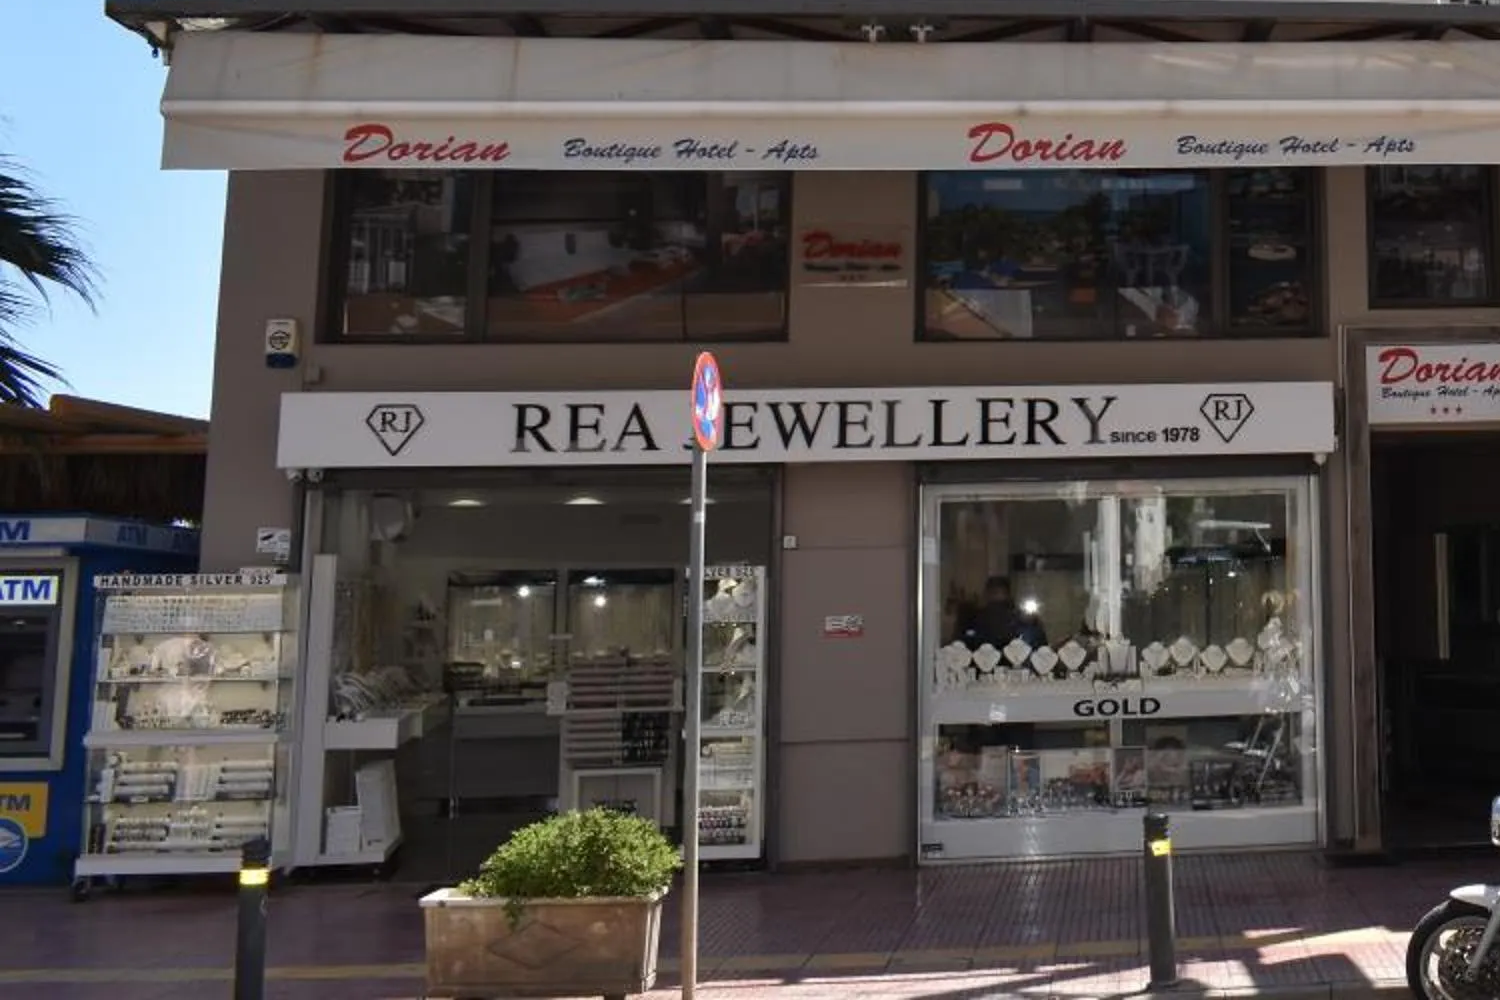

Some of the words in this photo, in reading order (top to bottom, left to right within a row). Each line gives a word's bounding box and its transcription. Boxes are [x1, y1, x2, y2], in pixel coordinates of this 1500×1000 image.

[343, 123, 511, 163] Dorian
[564, 138, 663, 162] Boutique
[673, 138, 739, 160] Hotel
[762, 138, 819, 162] Apts
[967, 122, 1126, 164] Dorian
[1176, 135, 1269, 157] Boutique
[1279, 135, 1341, 155] Hotel
[1362, 135, 1415, 158] Apts
[1436, 385, 1468, 397] Hotel
[1215, 400, 1242, 421] RJ
[379, 411, 412, 433] RJ
[510, 402, 660, 453] REA
[683, 396, 1118, 454] EWELLERY
[1109, 429, 1157, 443] since
[1161, 427, 1200, 443] 1978
[0, 579, 50, 600] TM
[101, 576, 182, 587] HANDMADE
[190, 575, 243, 586] SILVER
[1073, 696, 1161, 717] GOLD
